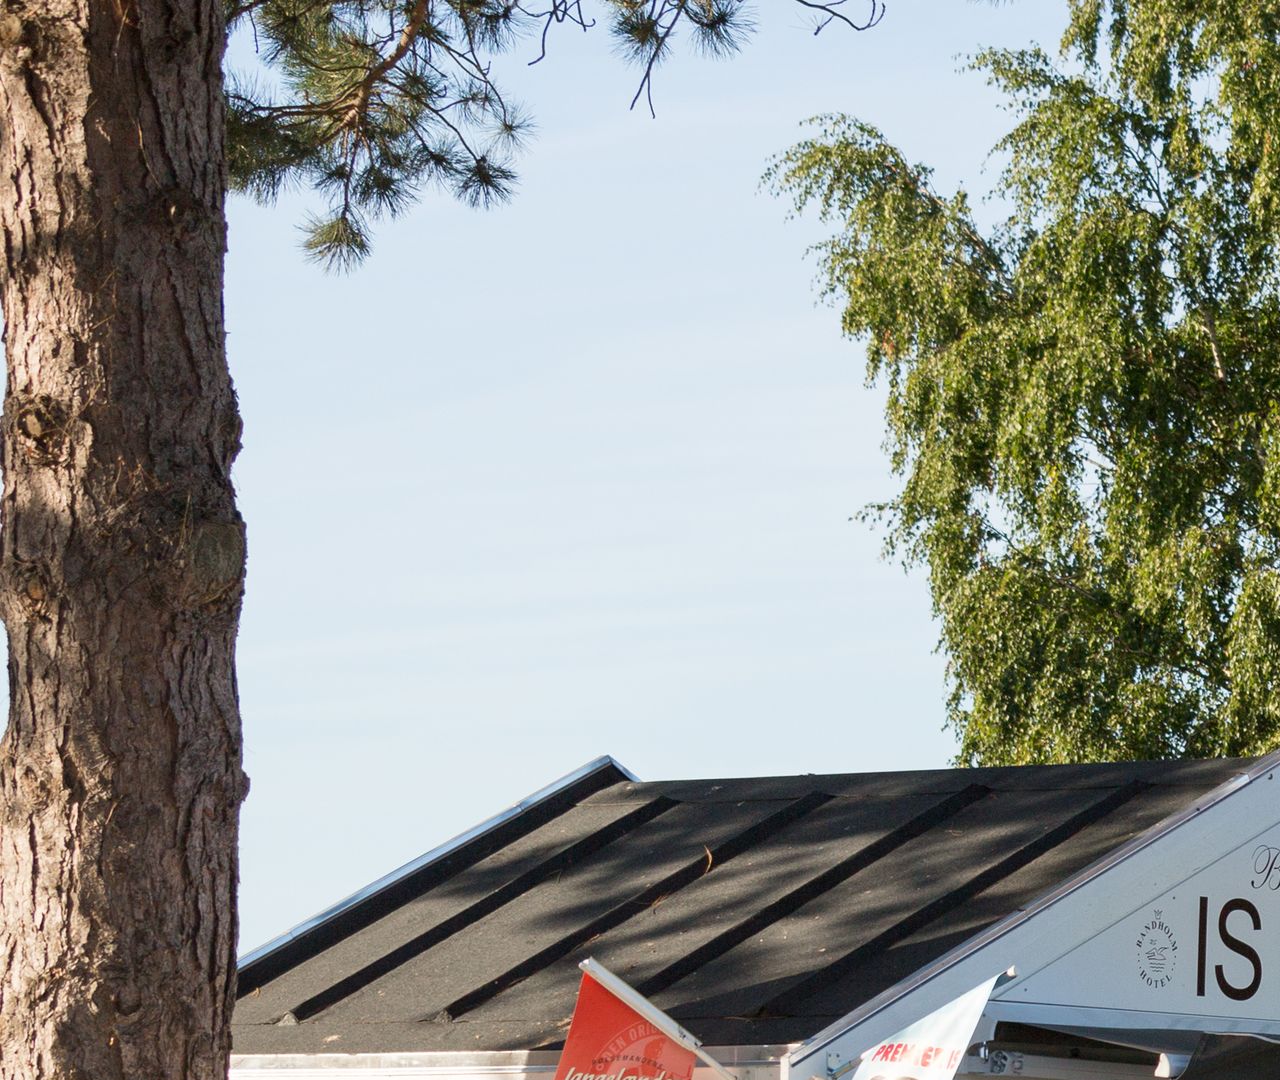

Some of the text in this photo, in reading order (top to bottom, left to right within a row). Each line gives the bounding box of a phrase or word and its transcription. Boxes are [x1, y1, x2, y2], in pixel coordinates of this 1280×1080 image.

[1135, 920, 1178, 953] BANDHOLM
[1196, 896, 1262, 1001] IS
[1139, 969, 1174, 990] HOTEL
